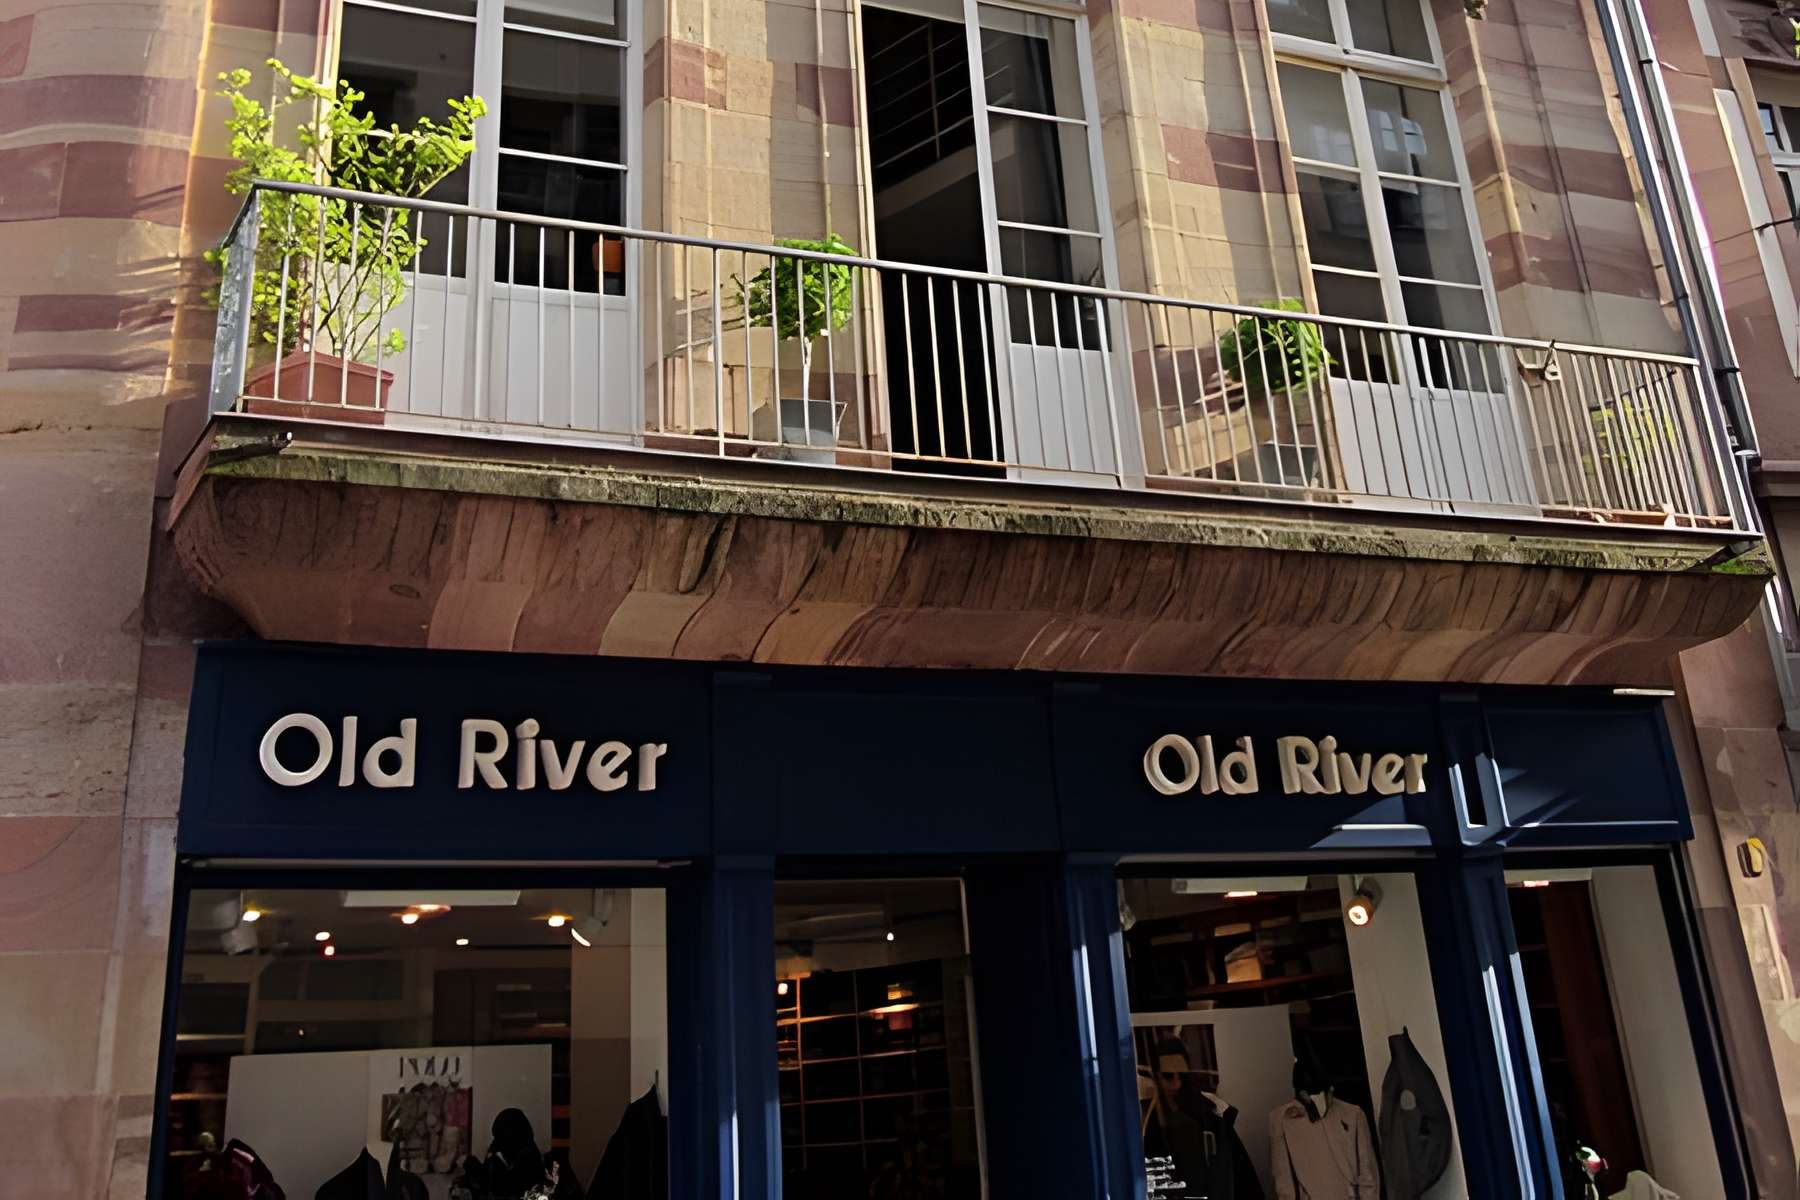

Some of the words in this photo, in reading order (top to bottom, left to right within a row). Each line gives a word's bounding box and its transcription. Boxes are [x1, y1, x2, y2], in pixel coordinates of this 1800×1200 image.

[259, 712, 418, 788] Old
[457, 717, 669, 792] River
[1143, 733, 1259, 796] Old
[1277, 734, 1429, 796] River
